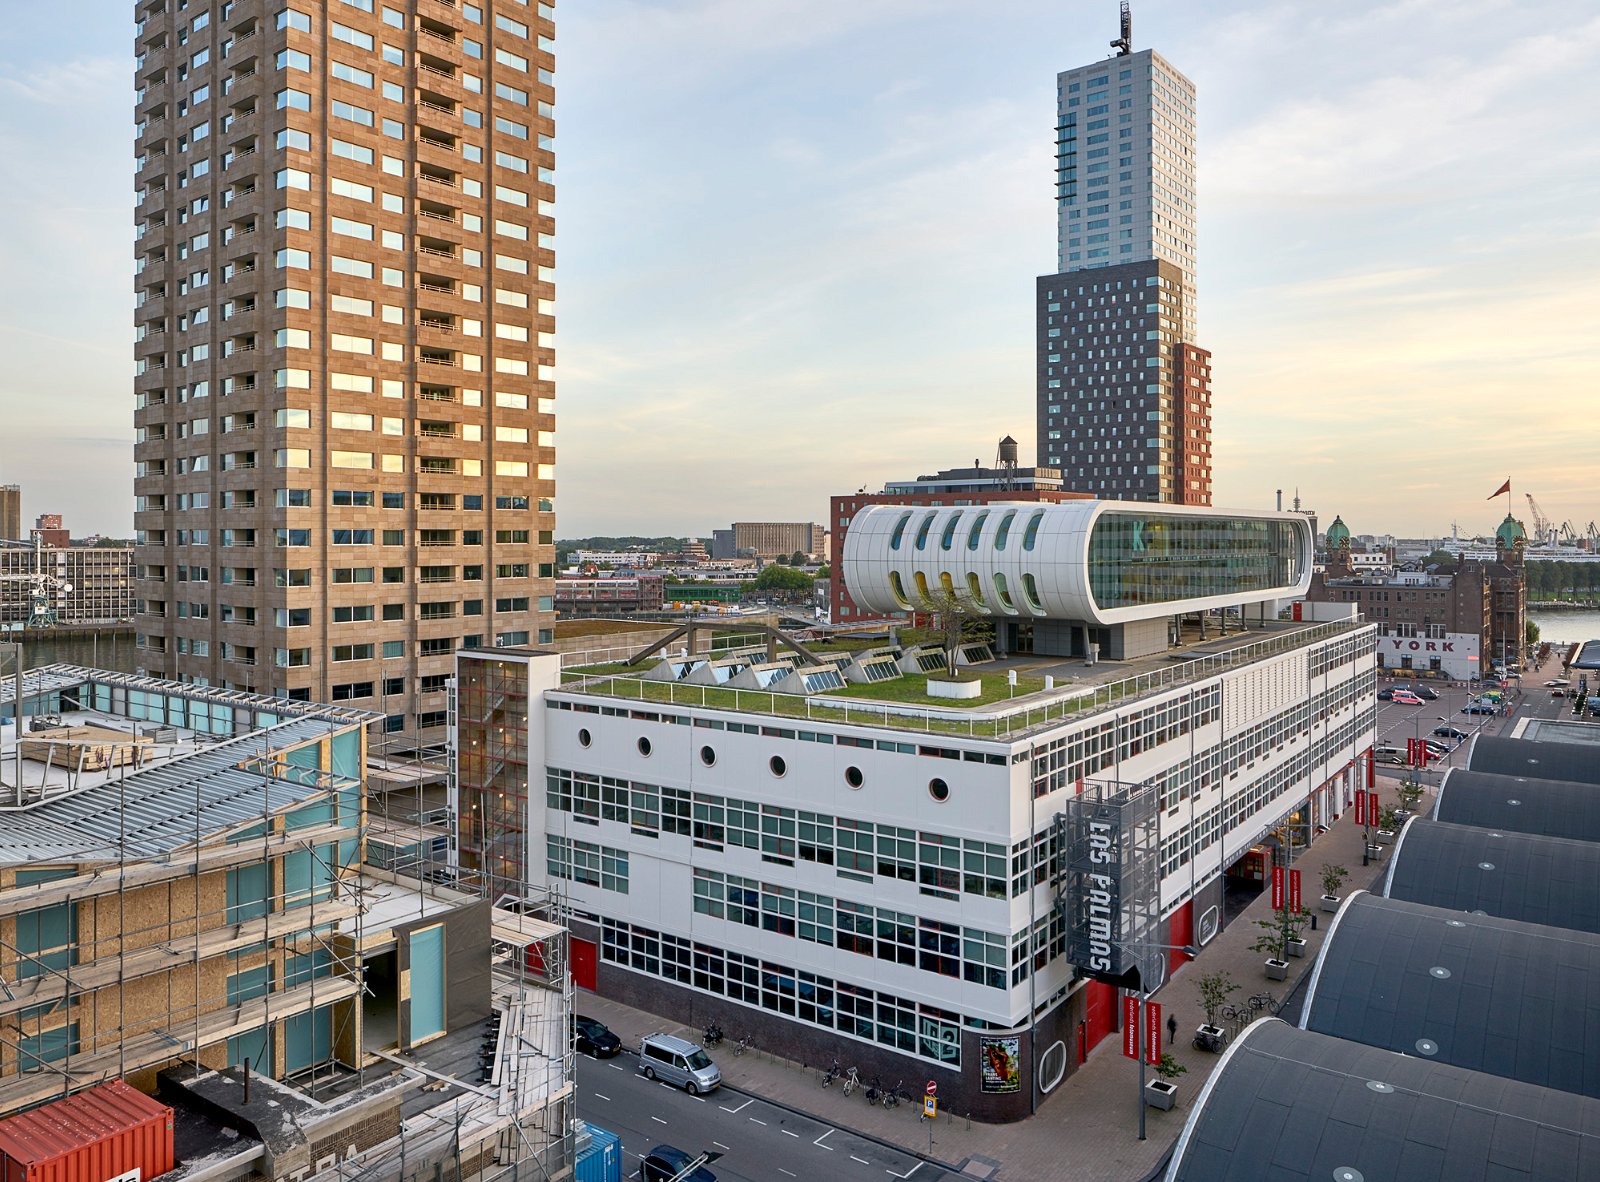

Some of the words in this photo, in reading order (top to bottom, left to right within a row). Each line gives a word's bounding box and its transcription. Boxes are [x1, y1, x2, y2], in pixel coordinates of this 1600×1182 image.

[1392, 640, 1454, 652] YORK
[1089, 822, 1111, 865] LAS
[1089, 873, 1111, 971] PALMAS
